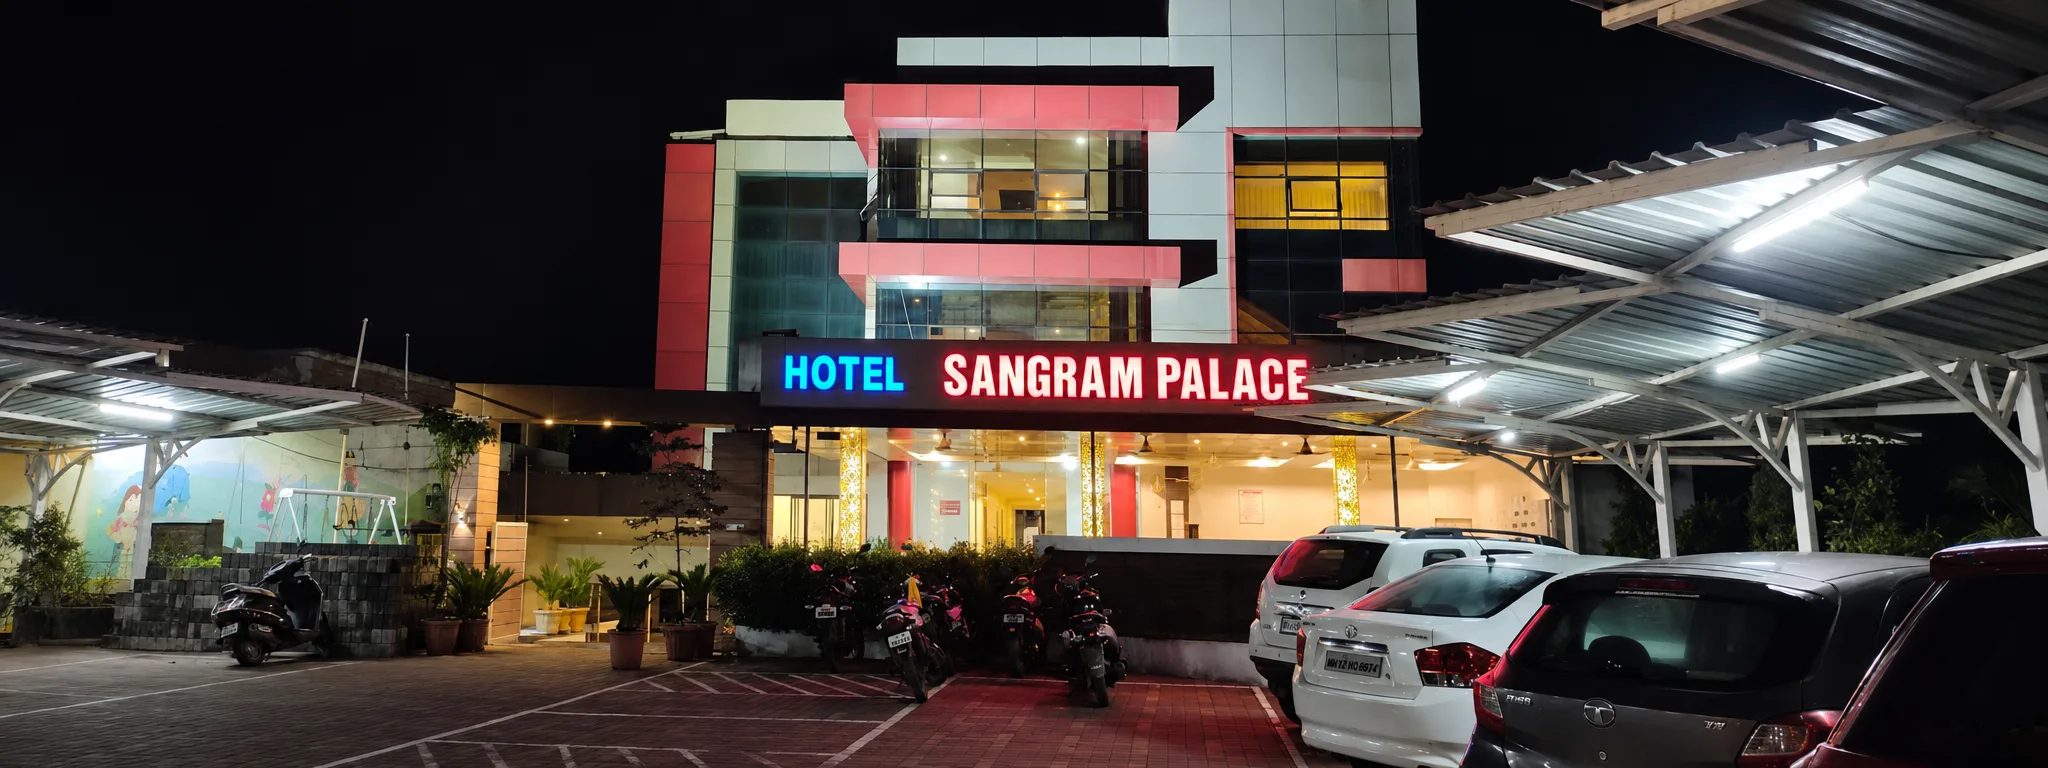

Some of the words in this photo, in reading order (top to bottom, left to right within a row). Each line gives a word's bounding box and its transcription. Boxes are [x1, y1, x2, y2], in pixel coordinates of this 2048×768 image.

[784, 355, 905, 391] HOTEL
[943, 353, 1143, 398] SANGRAM
[1156, 357, 1309, 401] PALACE
